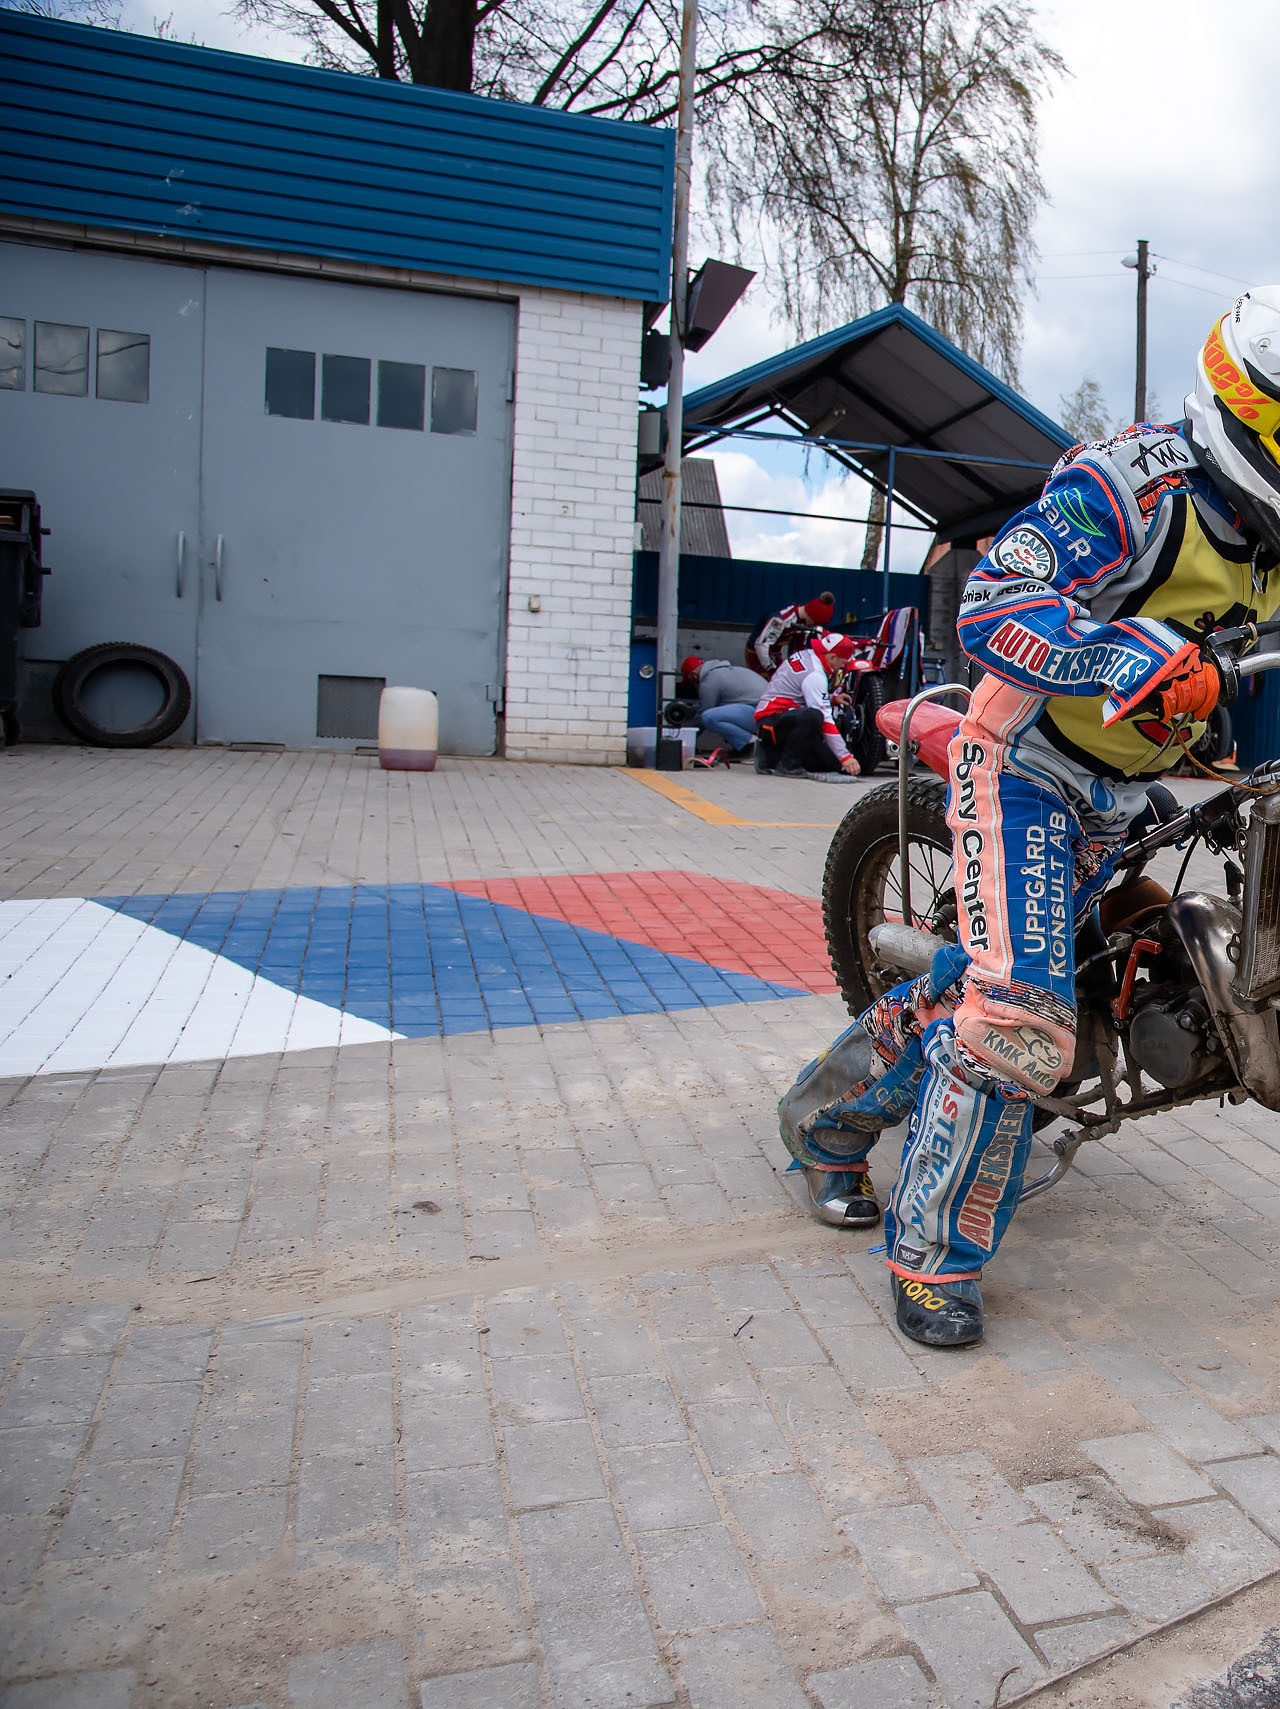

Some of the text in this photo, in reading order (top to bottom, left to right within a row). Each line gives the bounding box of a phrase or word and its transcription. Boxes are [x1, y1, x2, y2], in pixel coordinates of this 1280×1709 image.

[1010, 533, 1050, 572] SCANDIC
[956, 741, 990, 952] Sony Center
[1020, 825, 1046, 953] UPPGÅRD
[1048, 811, 1067, 978] KONSULT AB
[983, 1029, 1056, 1089] KMK Auto
